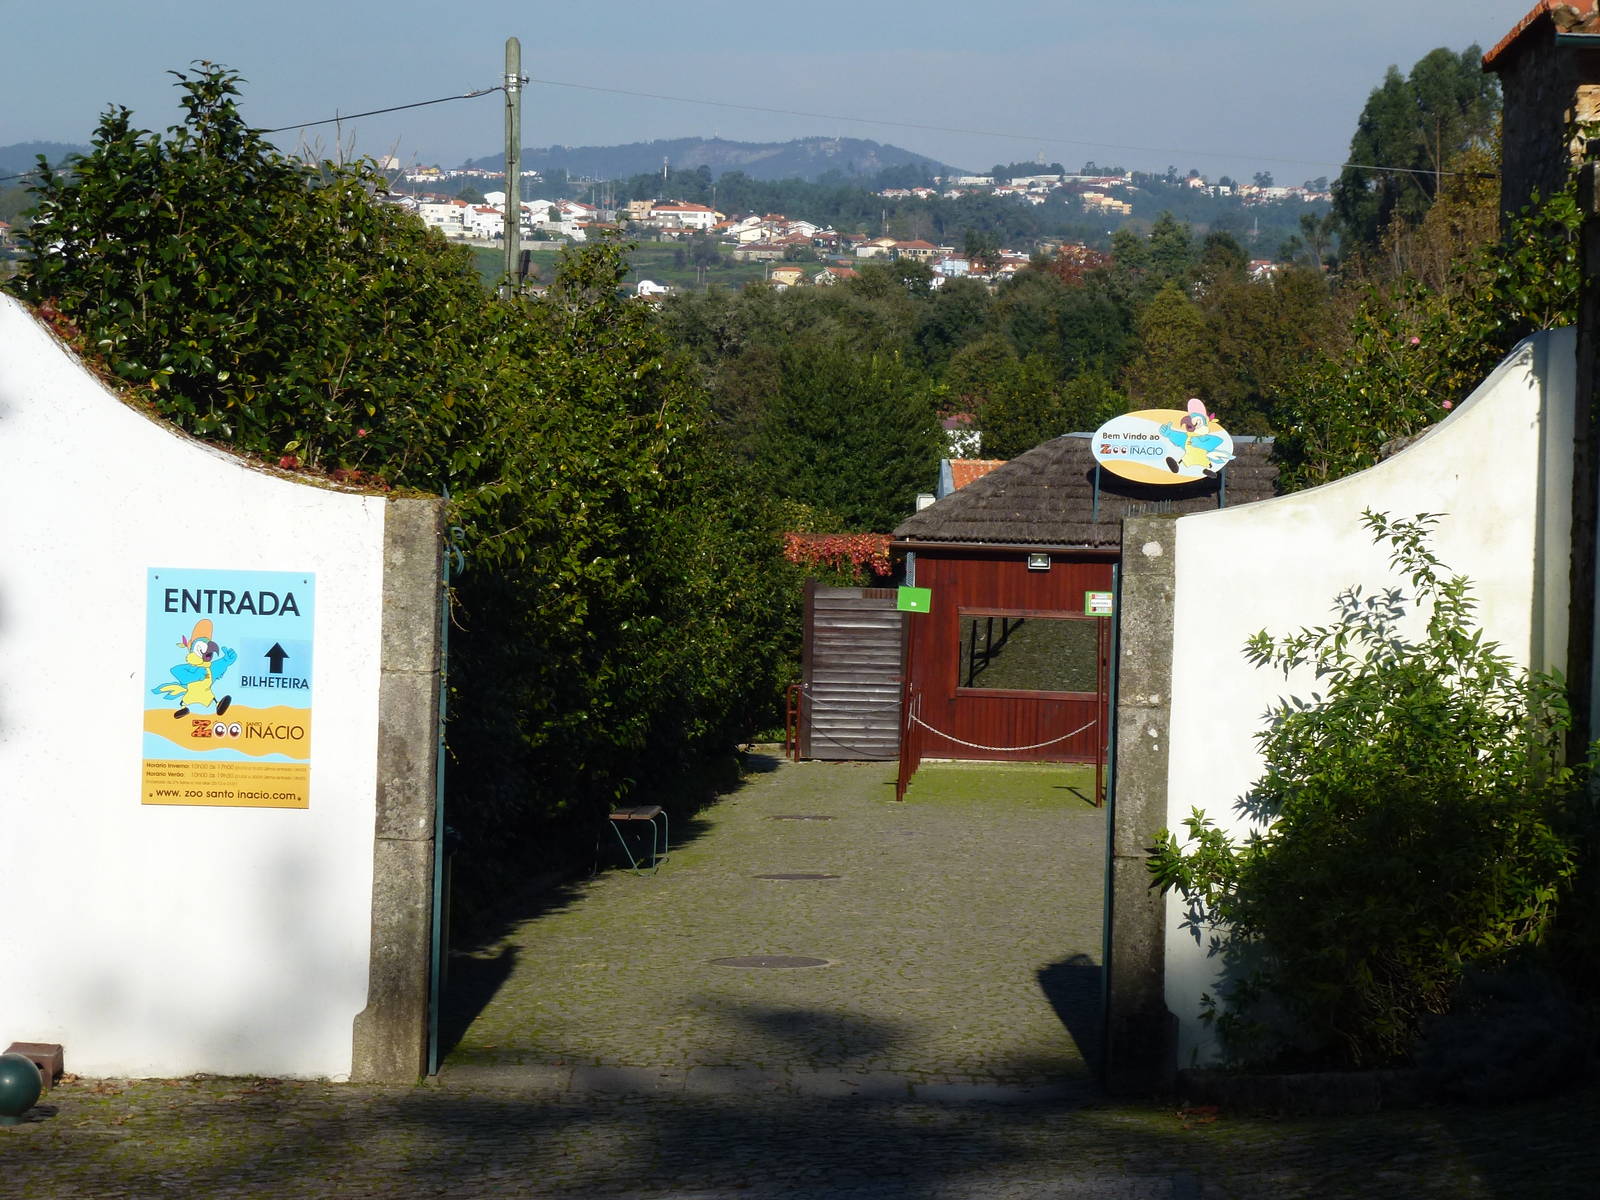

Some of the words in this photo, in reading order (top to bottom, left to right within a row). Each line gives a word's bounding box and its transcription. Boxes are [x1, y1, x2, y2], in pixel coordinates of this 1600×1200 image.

[1102, 432, 1120, 440] Bem
[1122, 433, 1148, 441] Vindo
[164, 588, 300, 616] ENTRADA
[241, 675, 309, 690] BILHETEIRA
[245, 722, 305, 740] INÁCIO
[155, 789, 181, 798] www.
[184, 790, 203, 798] zoo
[206, 789, 235, 799] santo
[237, 790, 296, 800] inacio.com
